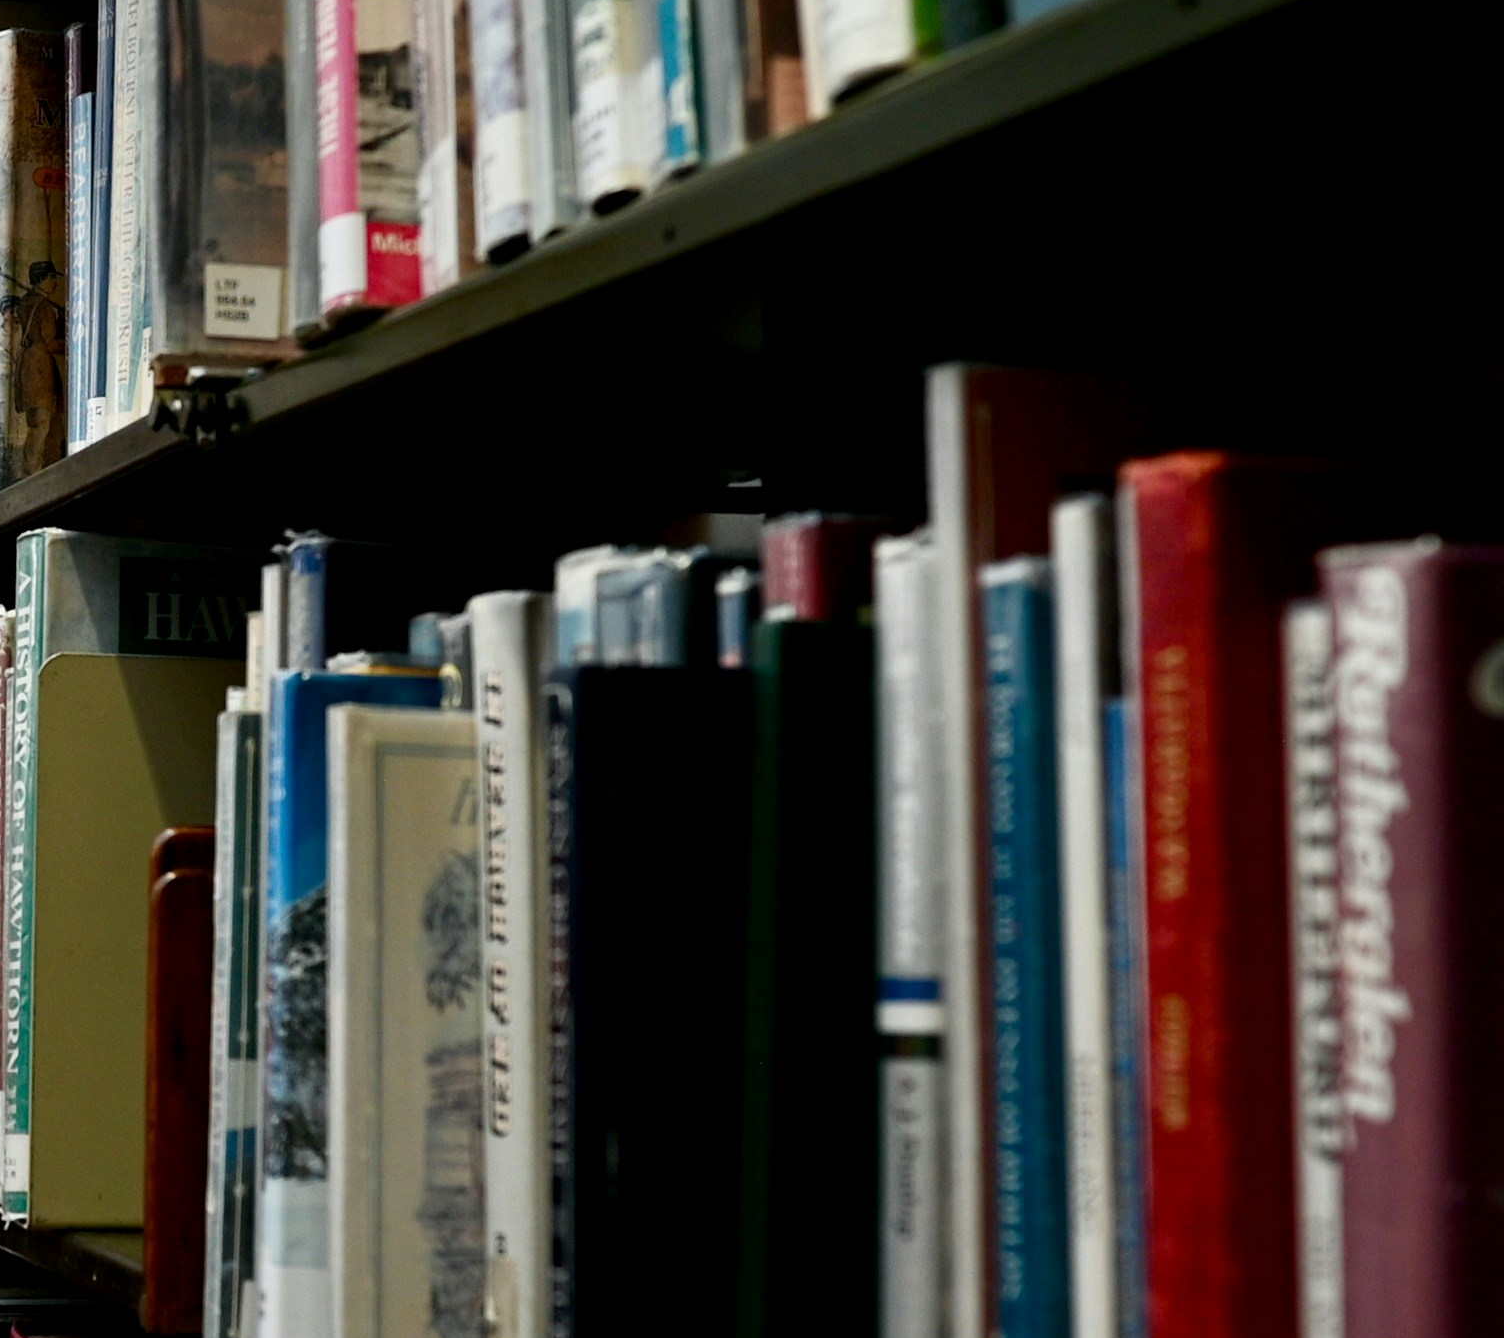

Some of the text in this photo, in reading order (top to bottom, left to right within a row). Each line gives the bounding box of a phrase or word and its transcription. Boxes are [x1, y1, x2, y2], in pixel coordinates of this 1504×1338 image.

[72, 122, 87, 343] BEARBRASS
[12, 605, 32, 768] HISTORY
[11, 779, 28, 830] OF
[485, 741, 511, 942] SEARCH
[1338, 563, 1413, 1131] Rutherglen
[6, 845, 26, 1074] HAWTHORN
